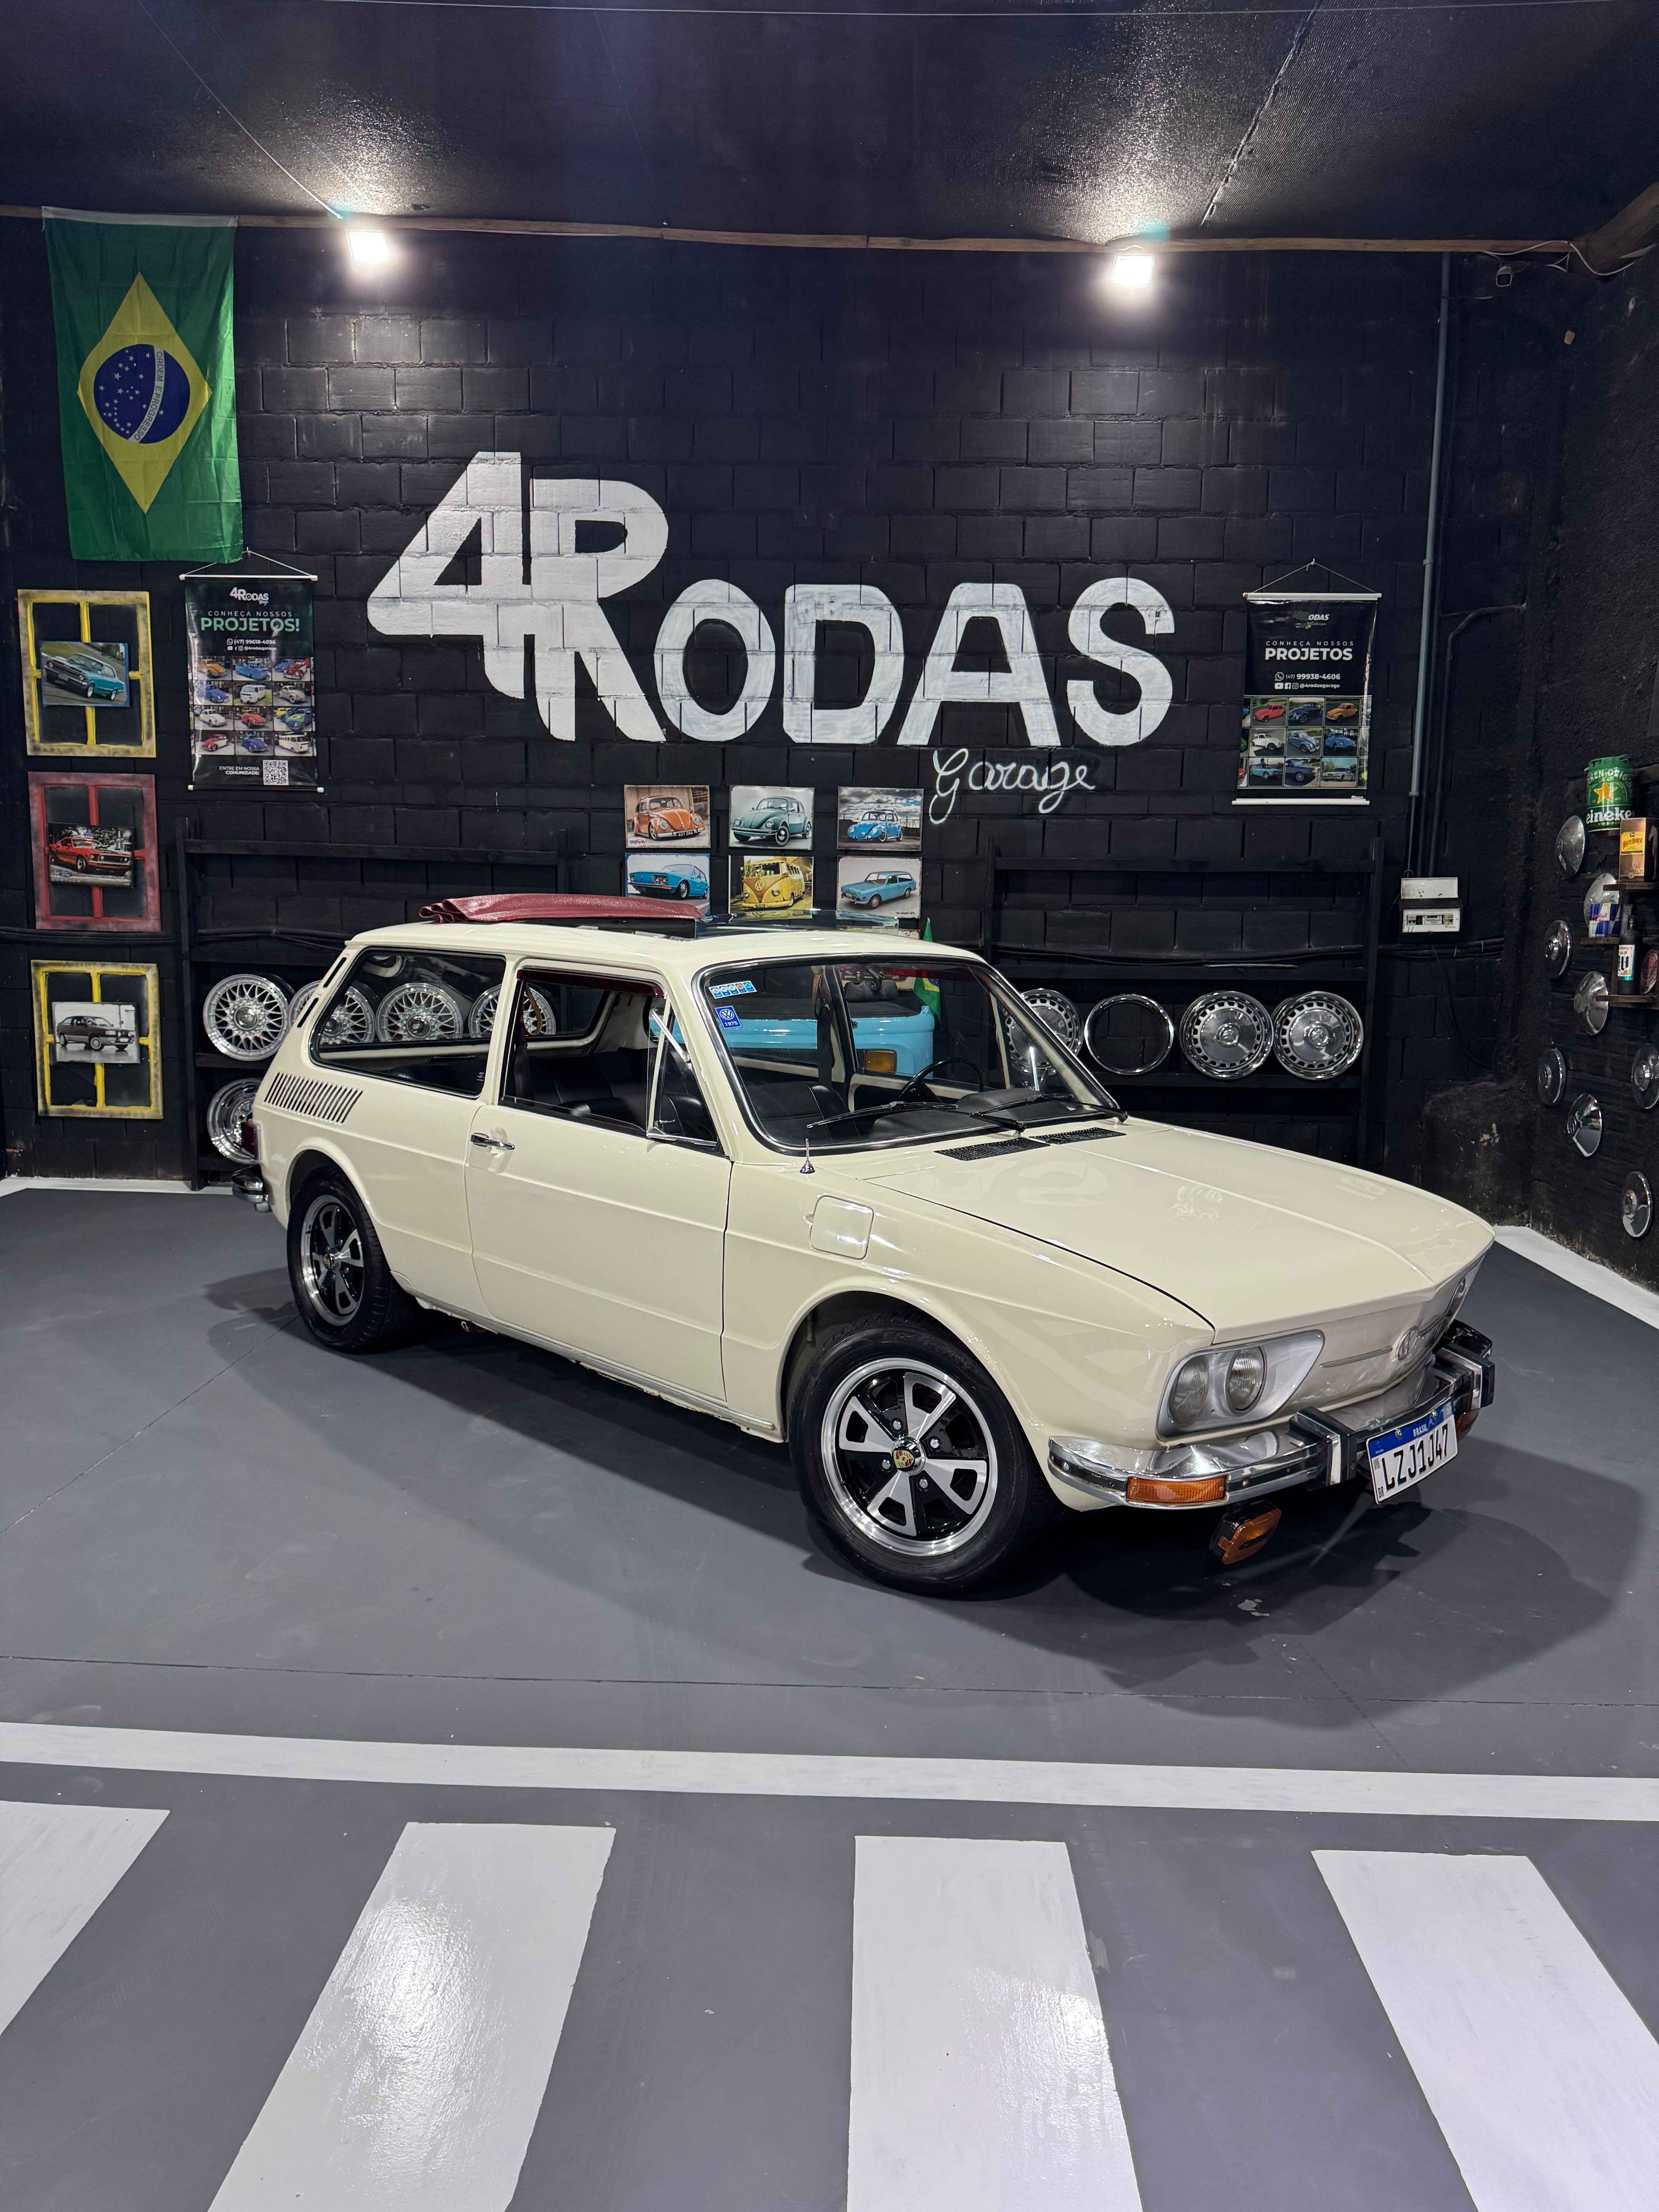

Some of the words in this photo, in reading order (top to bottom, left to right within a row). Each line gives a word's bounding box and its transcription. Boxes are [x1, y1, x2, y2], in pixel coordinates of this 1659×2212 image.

[134, 393, 160, 441] PROGRESSO
[201, 617, 300, 632] PROJETOS!
[1265, 648, 1353, 661] PROJETOS
[929, 748, 1096, 824] Garage
[1413, 1424, 1428, 1437] BRASIL
[1382, 1423, 1448, 1491] LZJ1J47
[1377, 1486, 1385, 1498] BR
